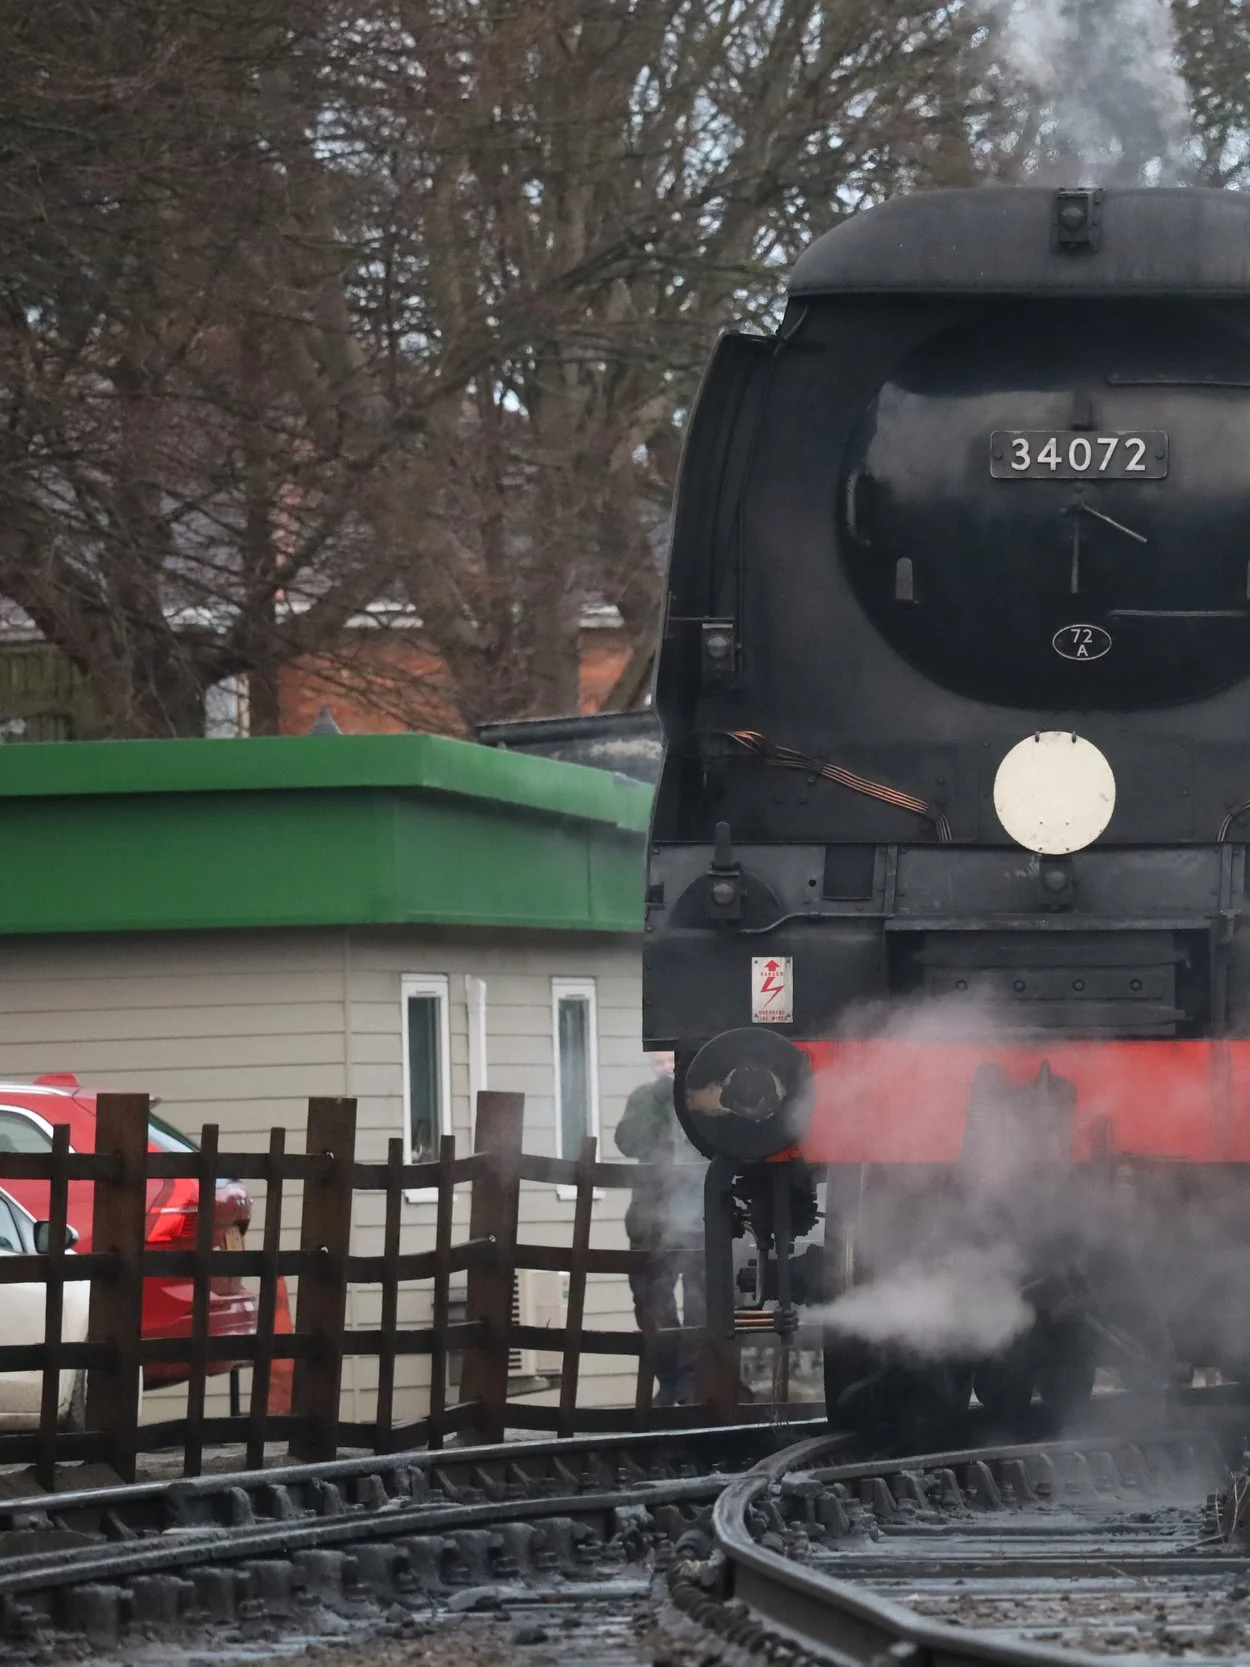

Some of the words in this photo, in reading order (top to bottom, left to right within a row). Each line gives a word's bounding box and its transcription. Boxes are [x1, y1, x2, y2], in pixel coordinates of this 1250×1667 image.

[1010, 437, 1146, 471] 34072
[1070, 629, 1093, 643] 72
[1076, 644, 1089, 657] A
